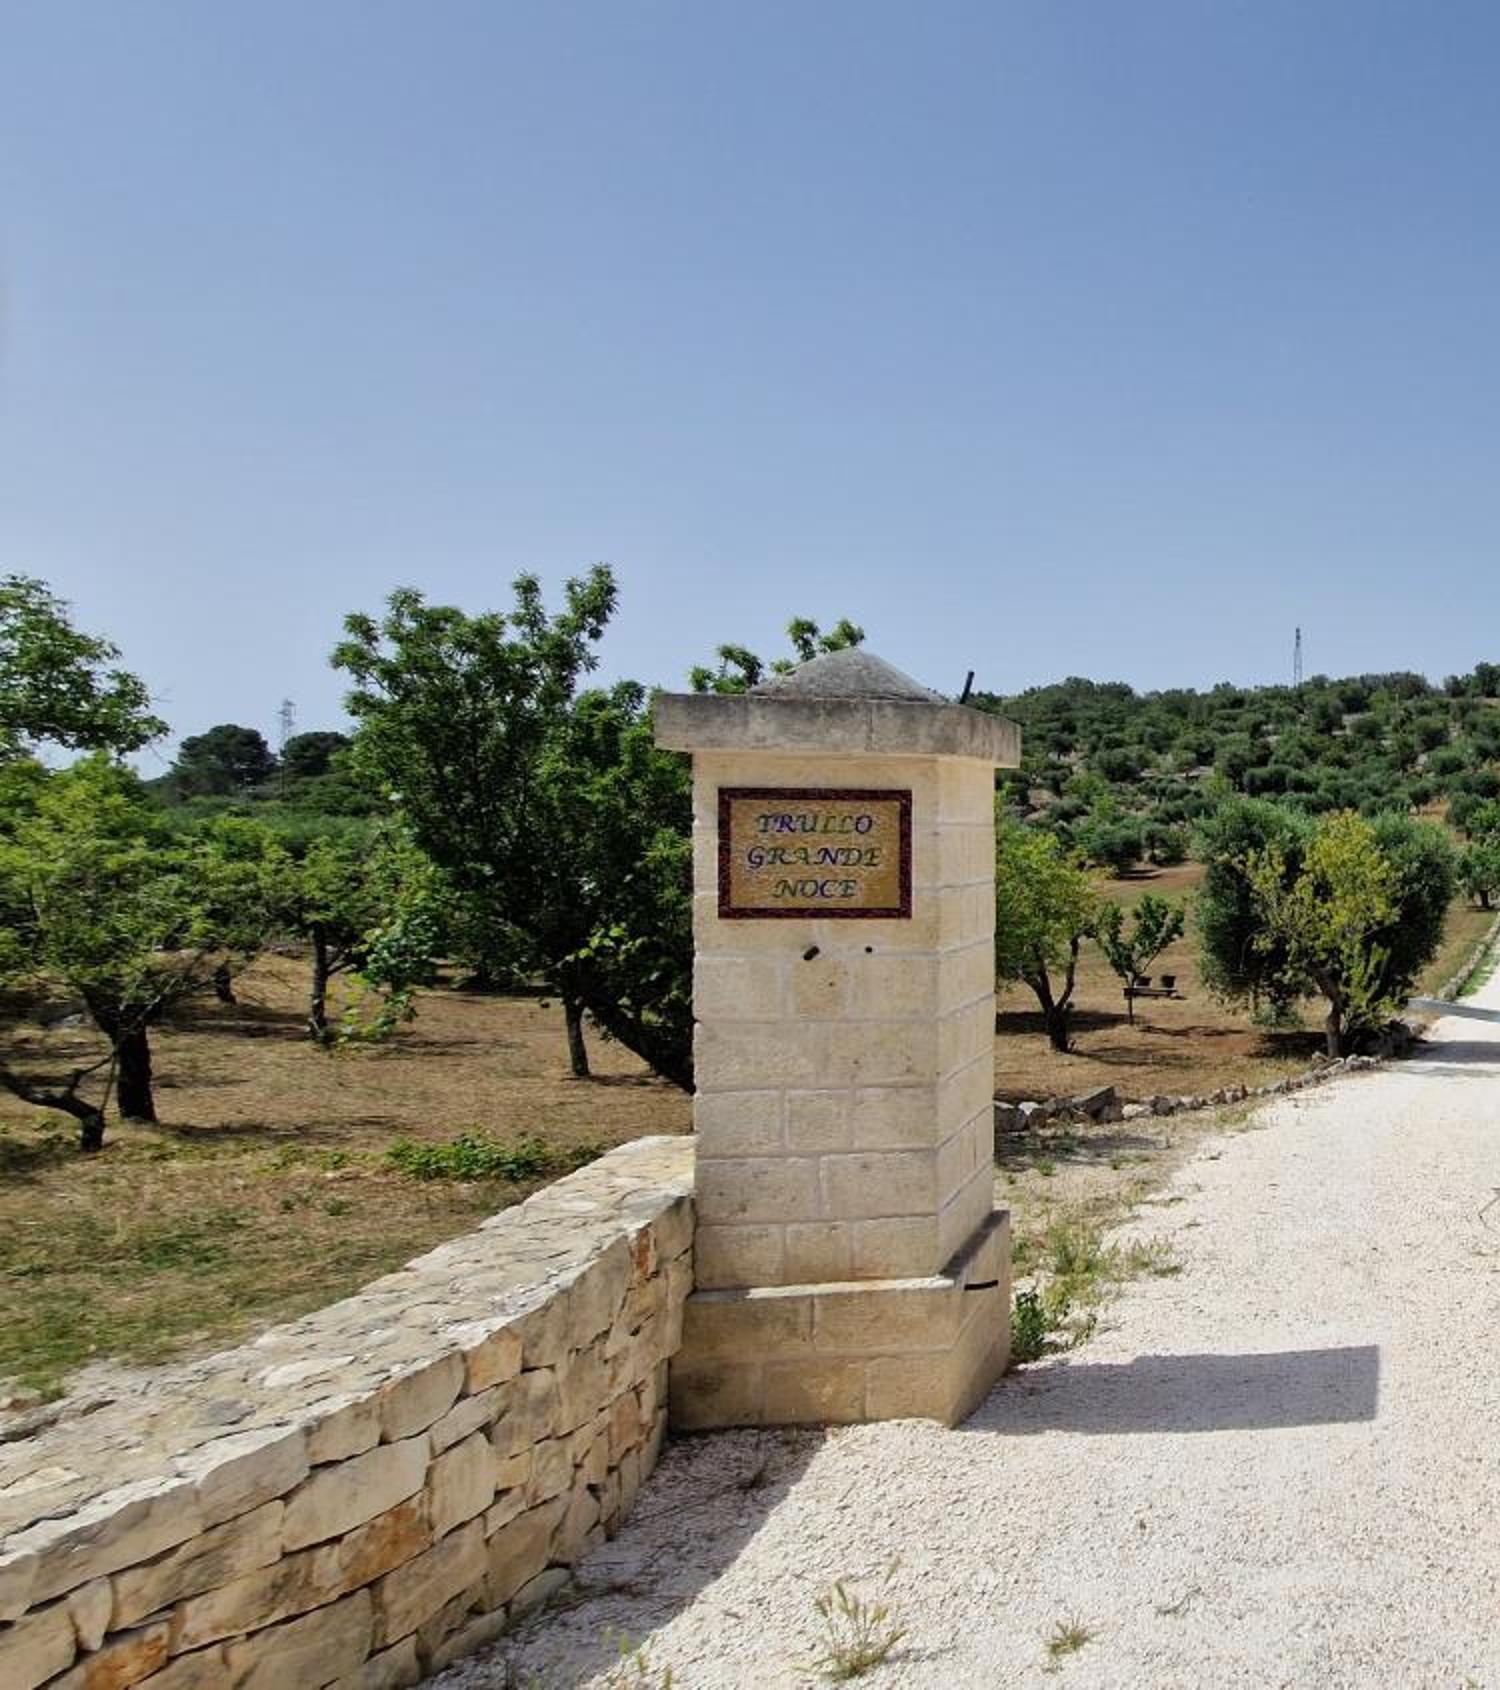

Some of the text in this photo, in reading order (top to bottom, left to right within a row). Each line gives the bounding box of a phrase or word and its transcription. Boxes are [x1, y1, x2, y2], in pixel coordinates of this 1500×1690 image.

[755, 813, 874, 835] TRULLO
[747, 846, 882, 869] GRANDE
[773, 879, 858, 899] NOCE
